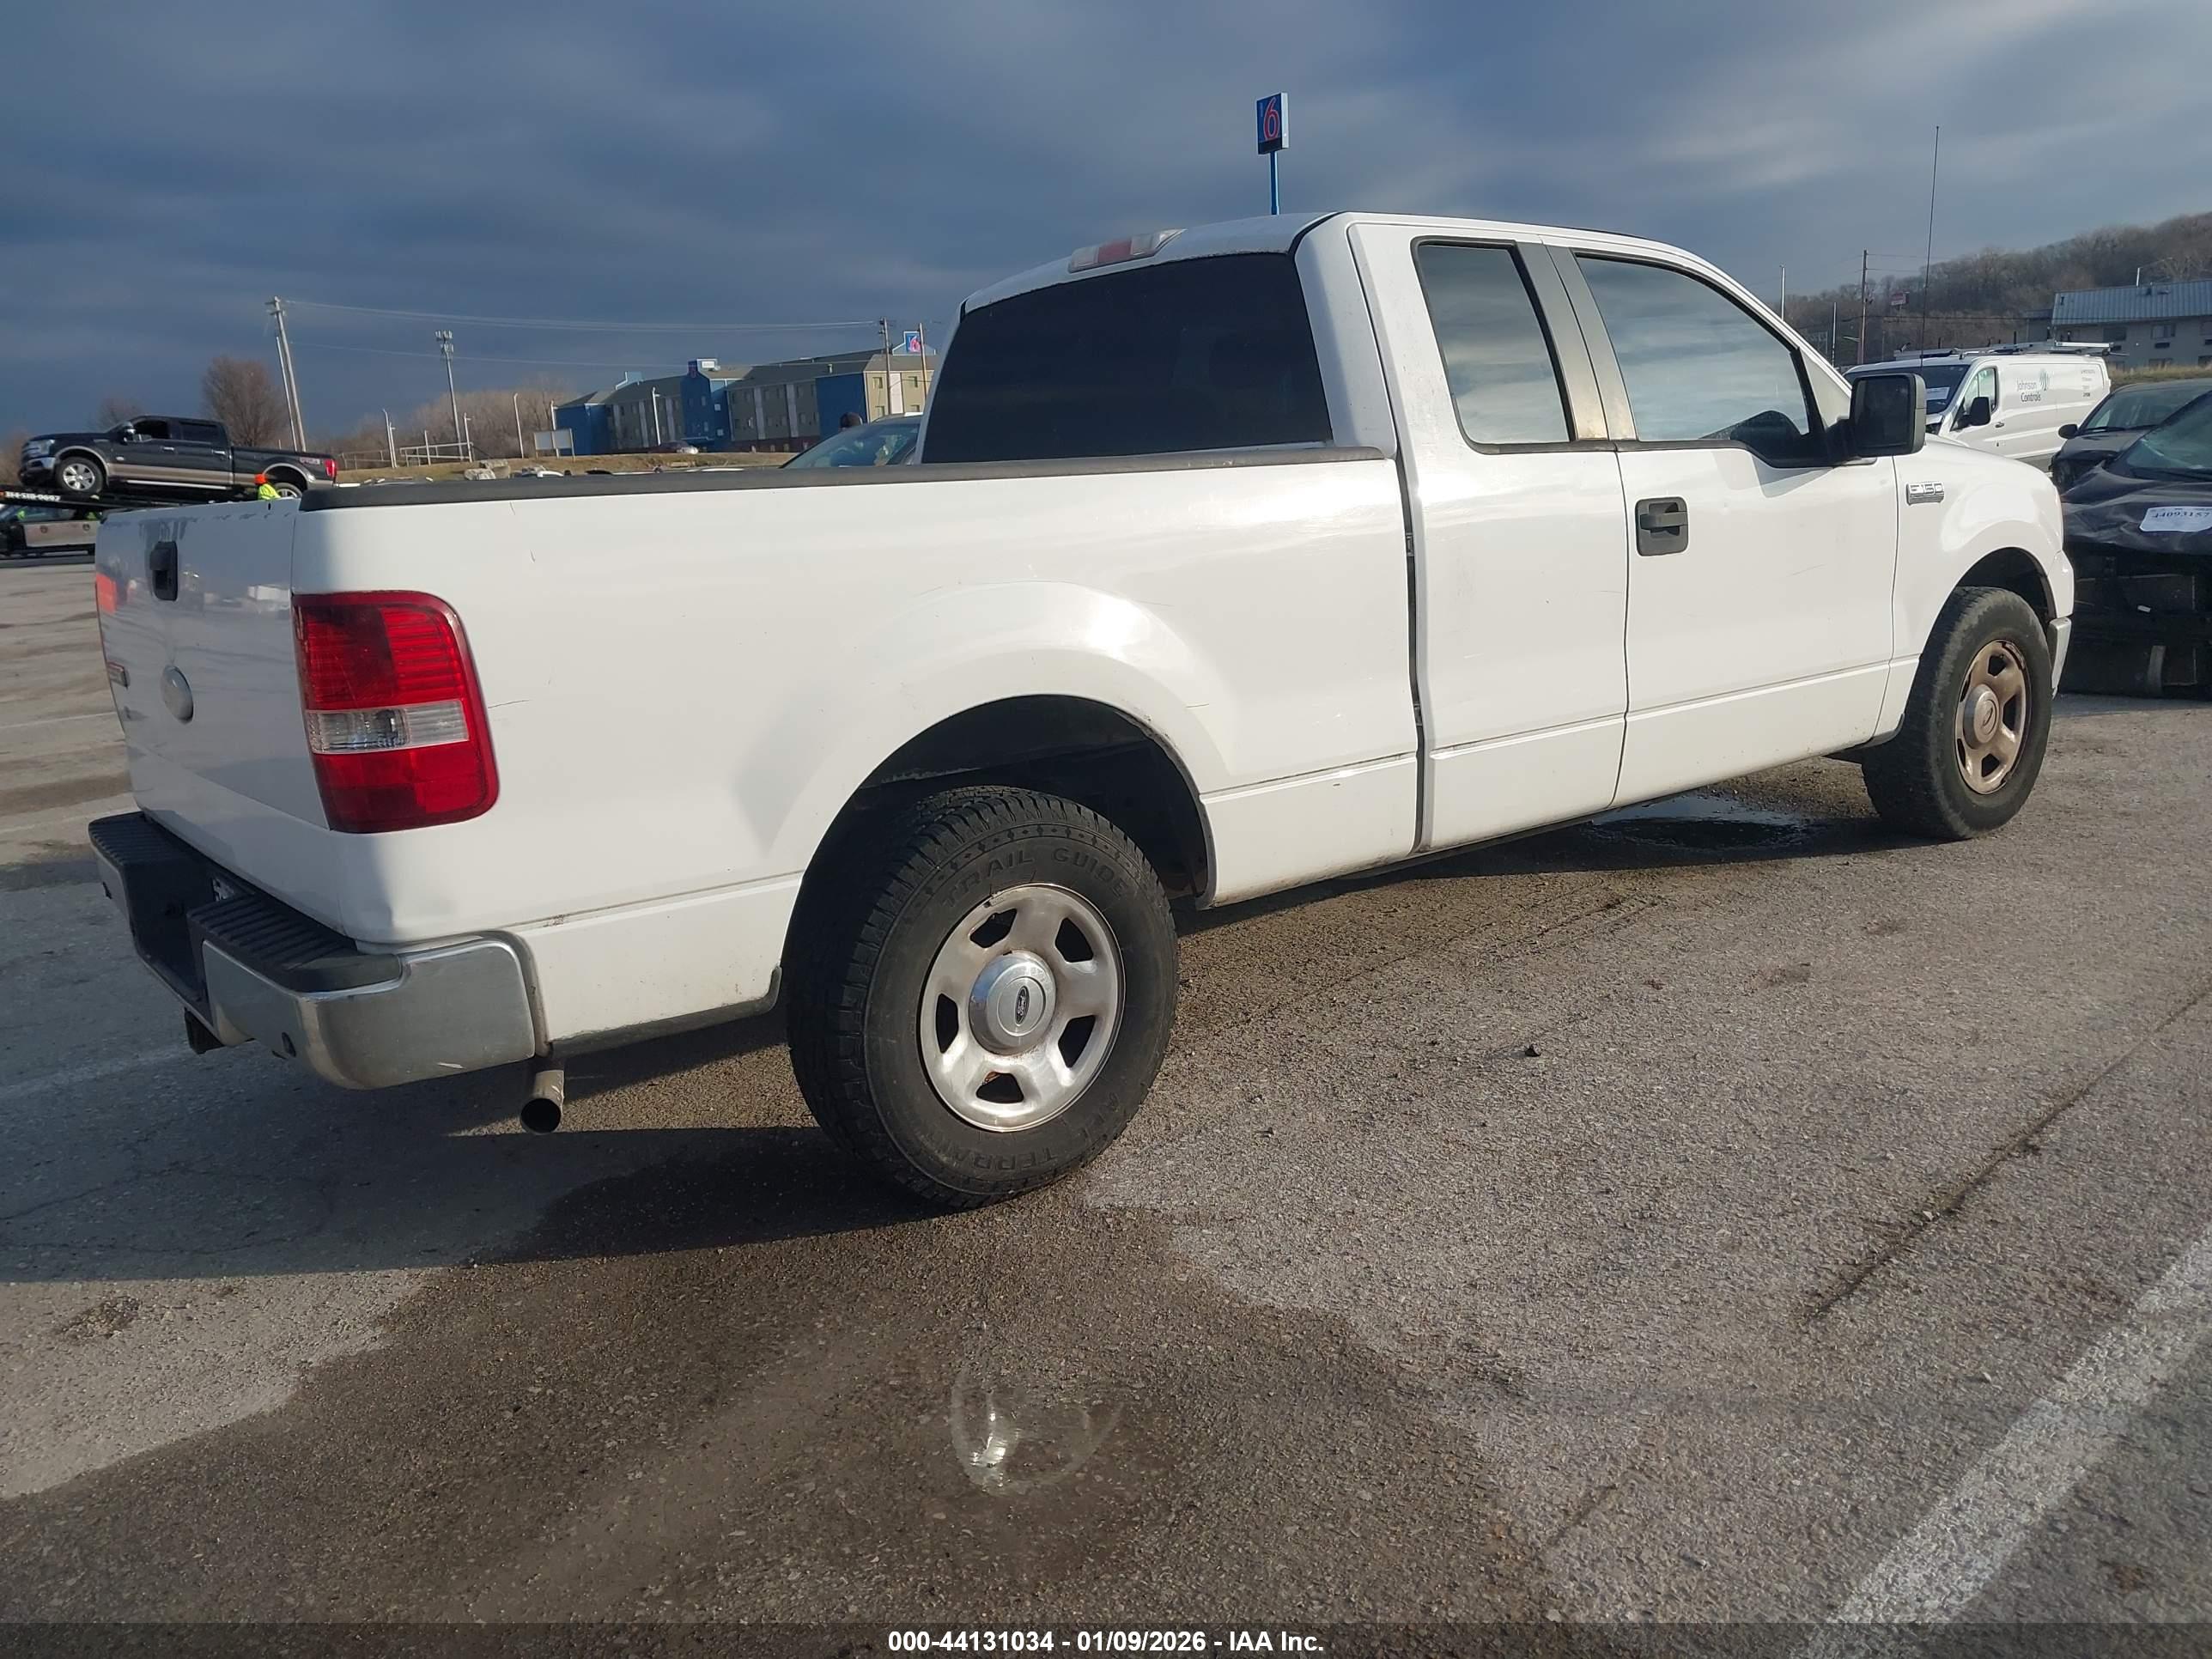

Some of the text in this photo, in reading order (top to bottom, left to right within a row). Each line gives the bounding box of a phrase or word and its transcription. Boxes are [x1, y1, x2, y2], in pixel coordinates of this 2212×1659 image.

[1263, 96, 1280, 140] 6
[2021, 392, 2041, 402] Controls
[940, 847, 1130, 908] TRAIL GUIDE
